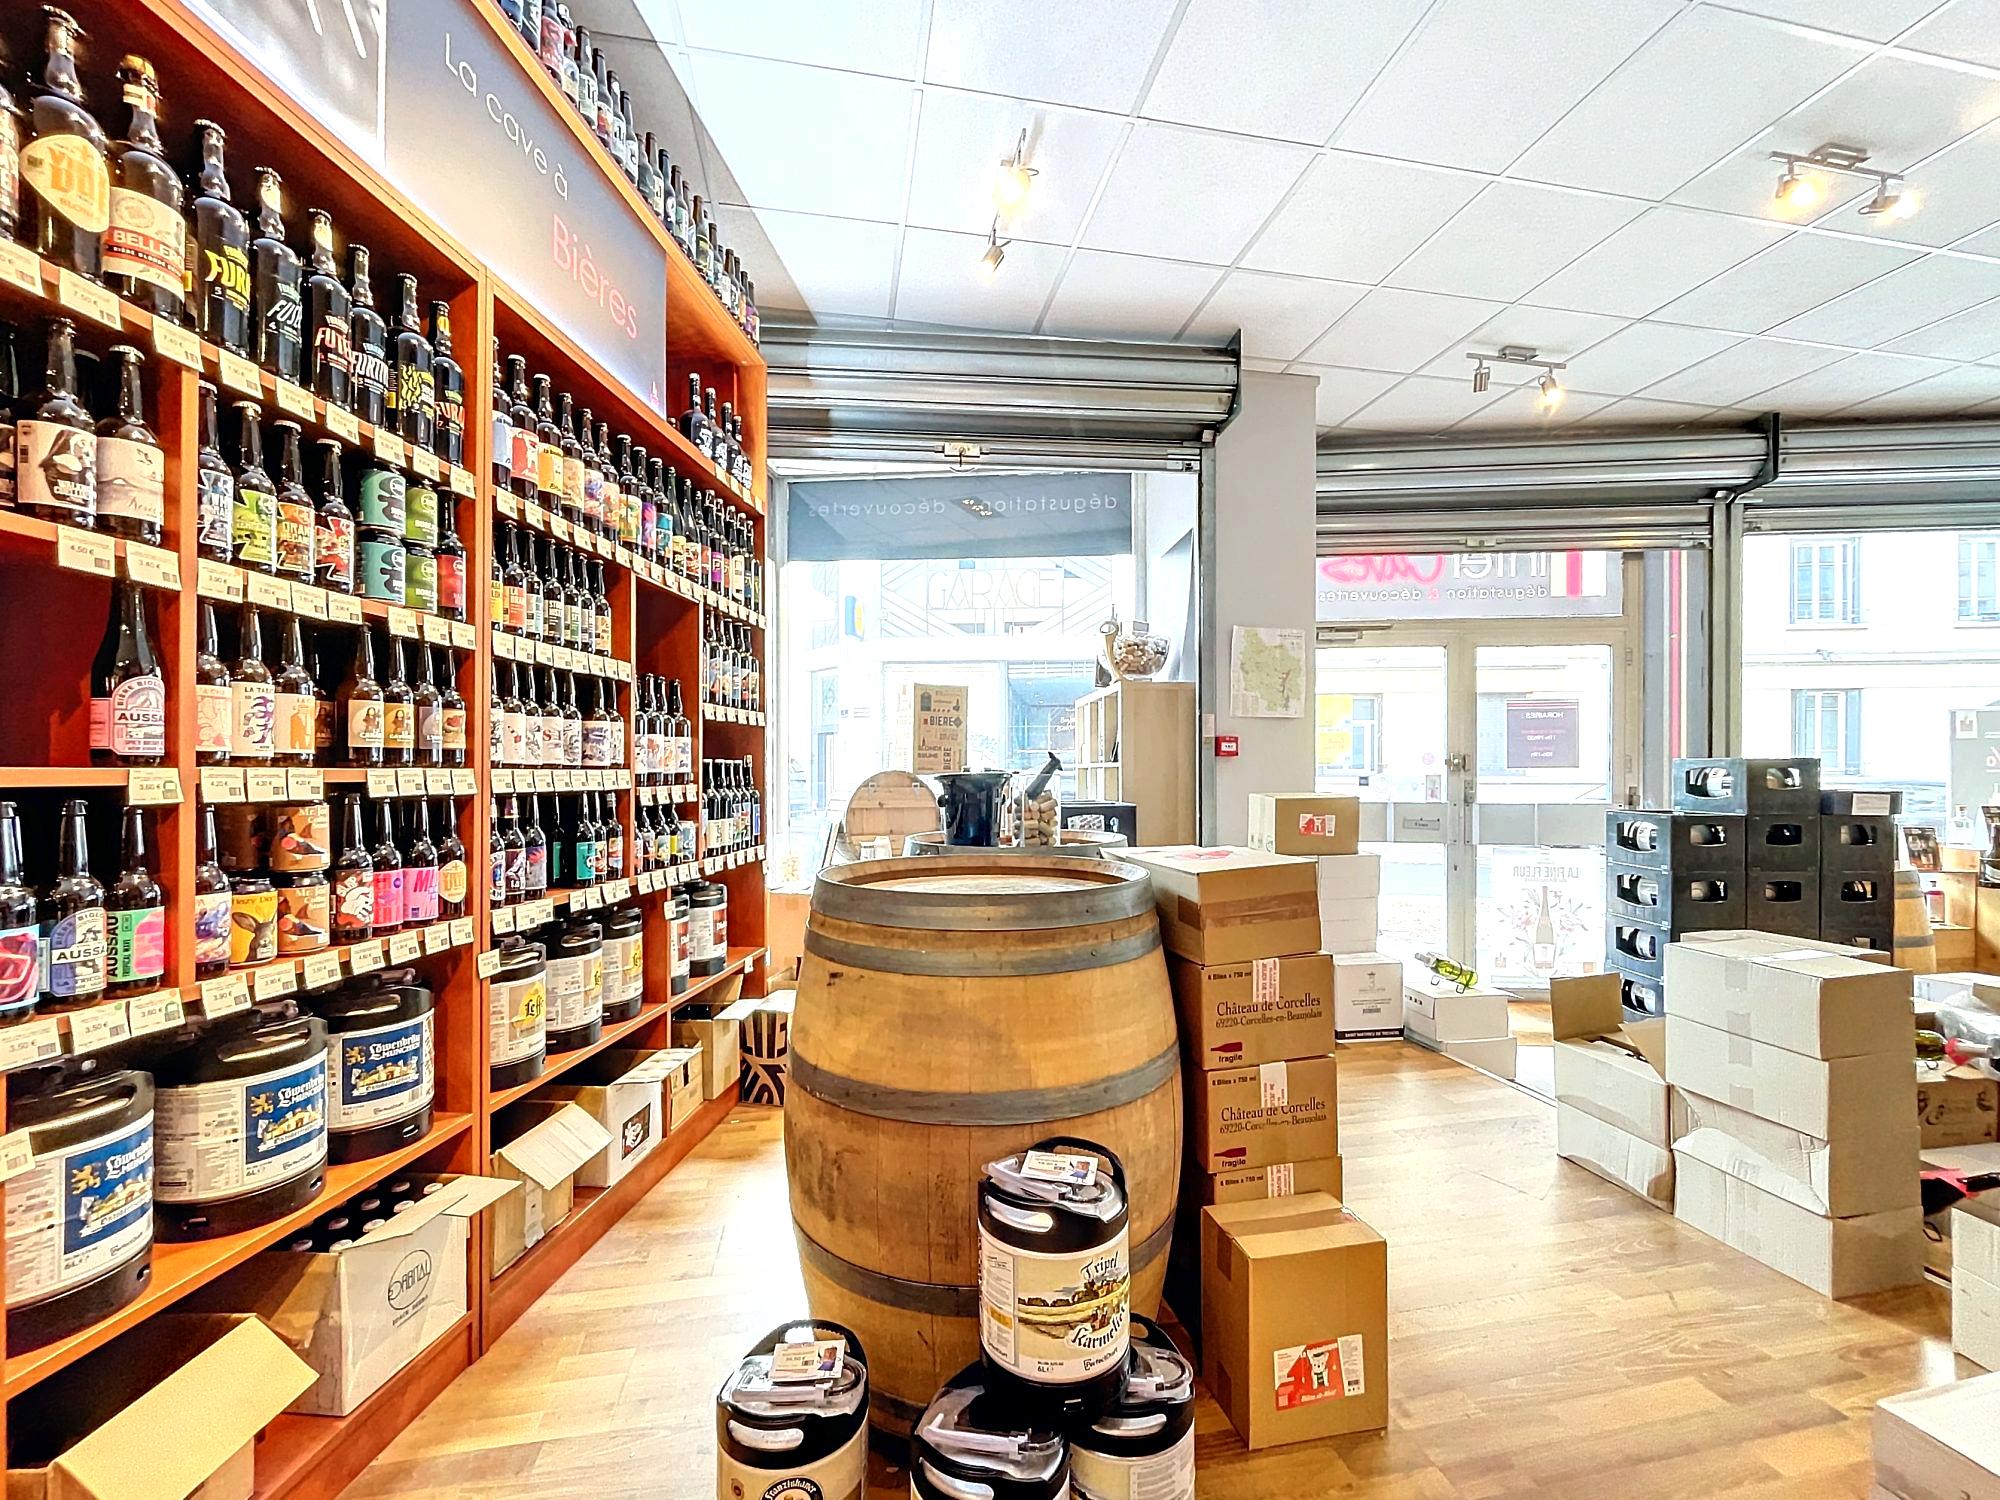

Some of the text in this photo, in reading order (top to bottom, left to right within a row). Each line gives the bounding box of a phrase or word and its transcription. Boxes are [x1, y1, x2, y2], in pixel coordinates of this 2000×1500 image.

[444, 33, 568, 200] La cave à
[552, 213, 638, 340] Bières
[927, 569, 1061, 609] GARAGE
[929, 715, 954, 727] BIERE
[106, 915, 119, 977] AUSSAU
[1216, 992, 1321, 1017] Château de Corcelles
[1218, 1054, 1243, 1064] fragile
[1221, 1105, 1264, 1122] Château
[1281, 1096, 1326, 1115] Corcelles
[1221, 1158, 1246, 1168] fragile
[1080, 1250, 1119, 1279] Tripel
